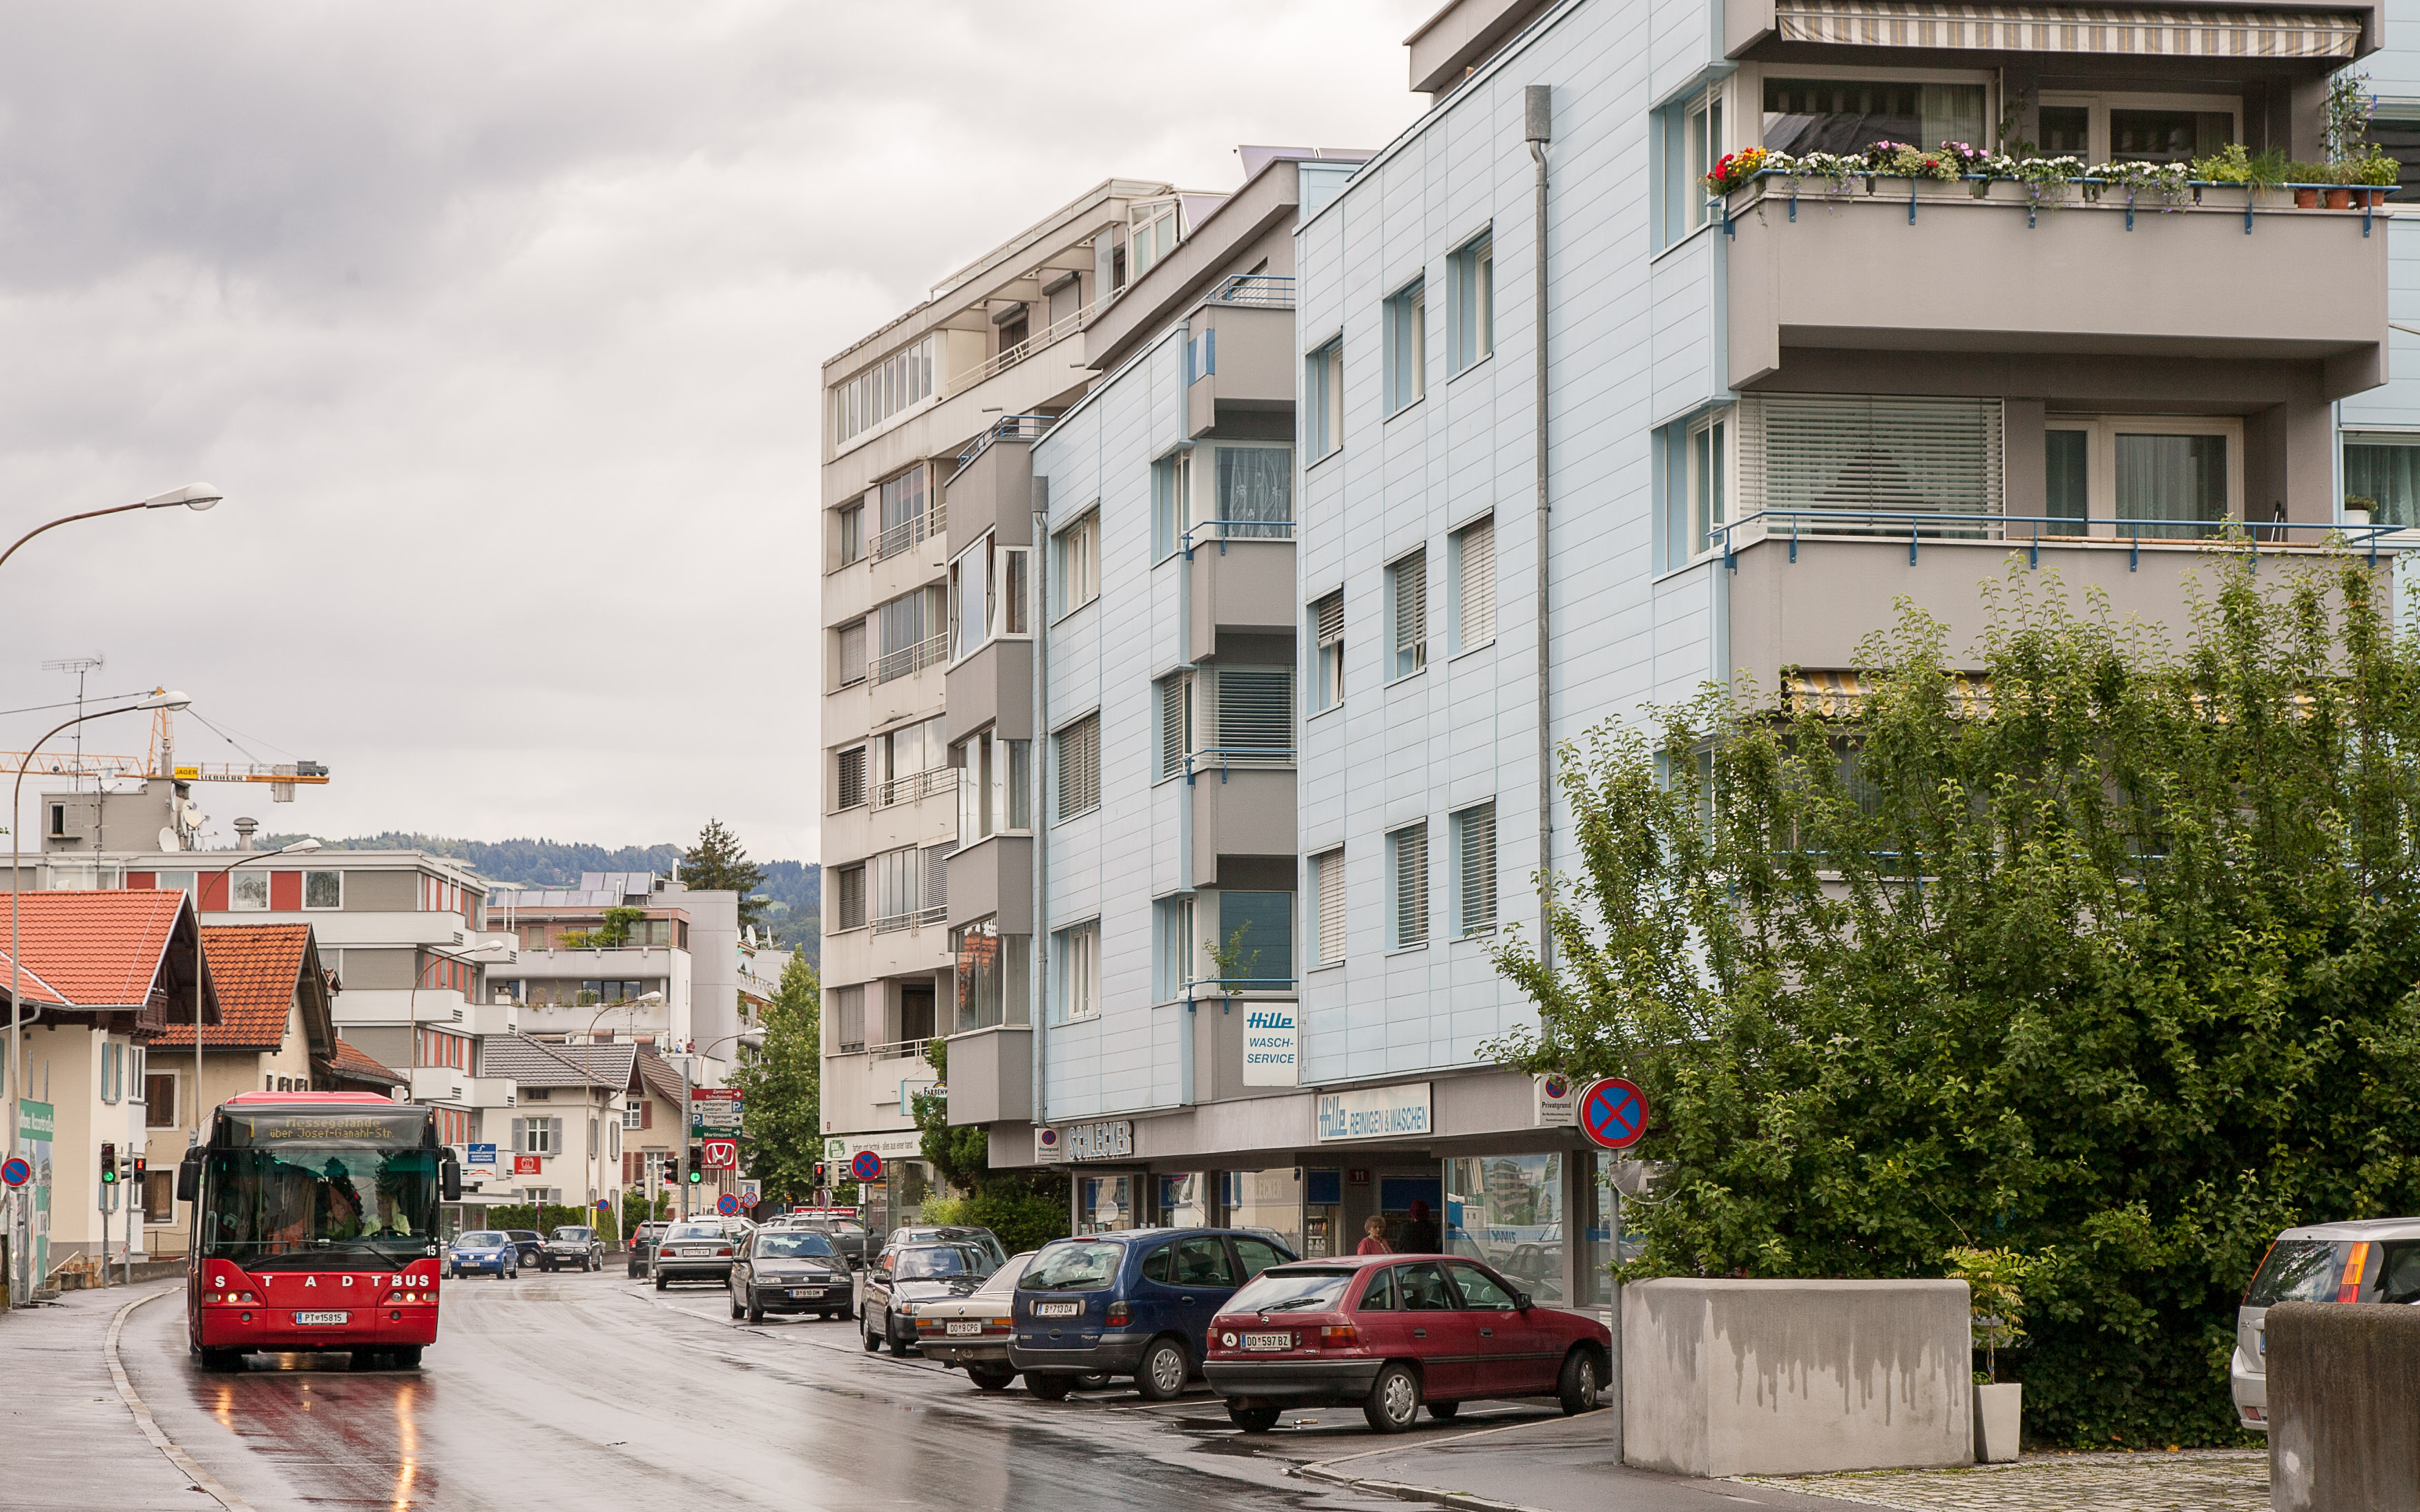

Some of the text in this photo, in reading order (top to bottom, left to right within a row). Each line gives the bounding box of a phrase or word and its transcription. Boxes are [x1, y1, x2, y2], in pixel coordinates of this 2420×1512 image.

[1247, 1012, 1295, 1028] Hille
[1249, 1038, 1294, 1047] WASCH-
[1247, 1054, 1295, 1063] SERVICE
[1542, 1101, 1571, 1109] Privatgrund
[1320, 1096, 1428, 1137] Hille REINIGEN & WASCHEN
[285, 1117, 381, 1128] Messegelände
[270, 1128, 293, 1138] über
[1068, 1121, 1132, 1160] SCHLECKER
[426, 1245, 436, 1256] 15
[1045, 1304, 1073, 1313] B 713 DA
[950, 1324, 958, 1332] DO
[967, 1324, 978, 1332] CPG
[1226, 1335, 1288, 1346] A DO 597 BZ
